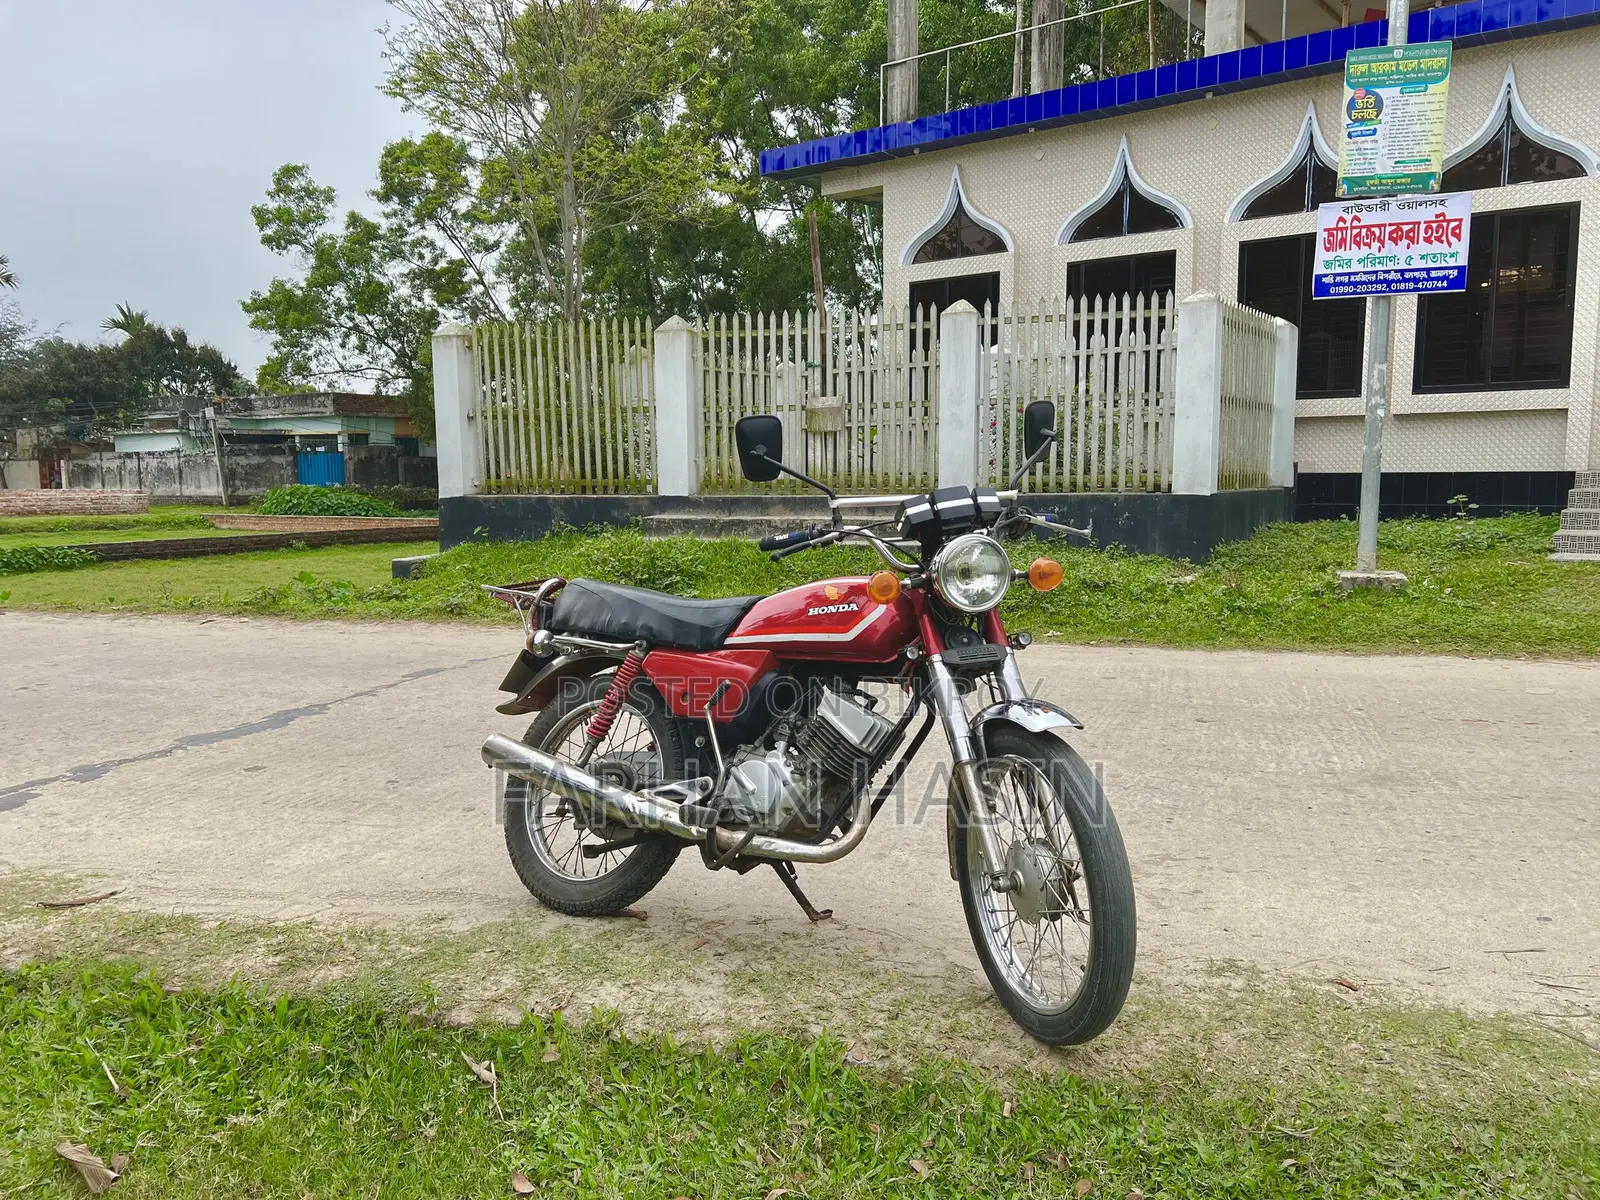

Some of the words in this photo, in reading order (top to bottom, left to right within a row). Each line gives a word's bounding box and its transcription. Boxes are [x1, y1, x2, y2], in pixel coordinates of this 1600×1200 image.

[1420, 56, 1447, 70] মাদরাসা
[1355, 96, 1376, 108] ভর্তি
[1352, 108, 1378, 120] চলছে
[1341, 200, 1392, 215] বাউন্ডারী
[1396, 198, 1448, 210] ওয়ালসহ
[1323, 214, 1348, 253] জমি
[1349, 214, 1387, 253] বিক্রয়
[1388, 220, 1422, 250] করা
[1422, 212, 1464, 249] হইবে
[1322, 256, 1353, 271] জমির
[1356, 252, 1400, 268] পরিমাণ:
[1404, 255, 1414, 266] ৫
[1419, 250, 1460, 264] শতাংশ
[1330, 284, 1389, 294] 01990-203292,
[1391, 280, 1448, 290] 01819-470744
[807, 602, 860, 616] HONDA
[957, 647, 995, 655] HONDA
